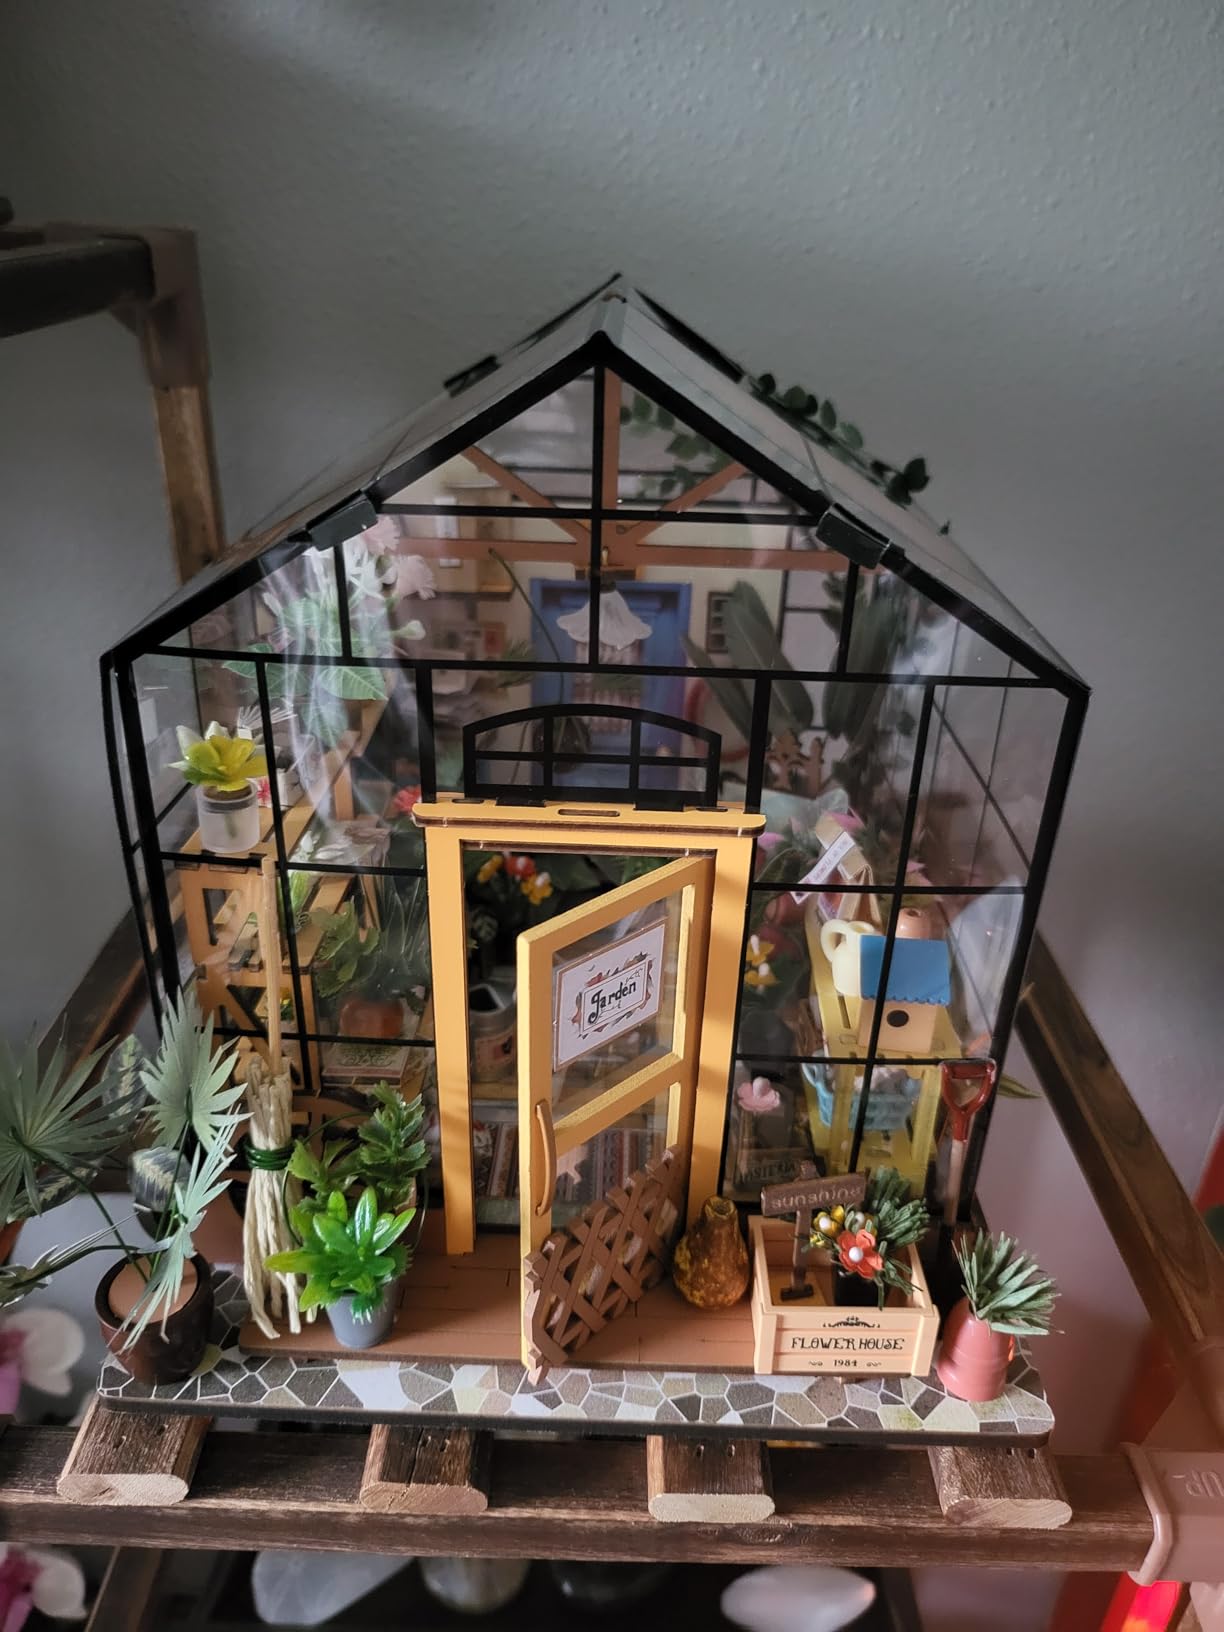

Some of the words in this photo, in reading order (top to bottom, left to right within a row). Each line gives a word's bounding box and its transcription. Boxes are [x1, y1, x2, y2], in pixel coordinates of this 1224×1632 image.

[791, 1337, 856, 1351] FLOWER
[858, 1338, 905, 1351] HOUSE
[833, 1359, 858, 1367] 1984
